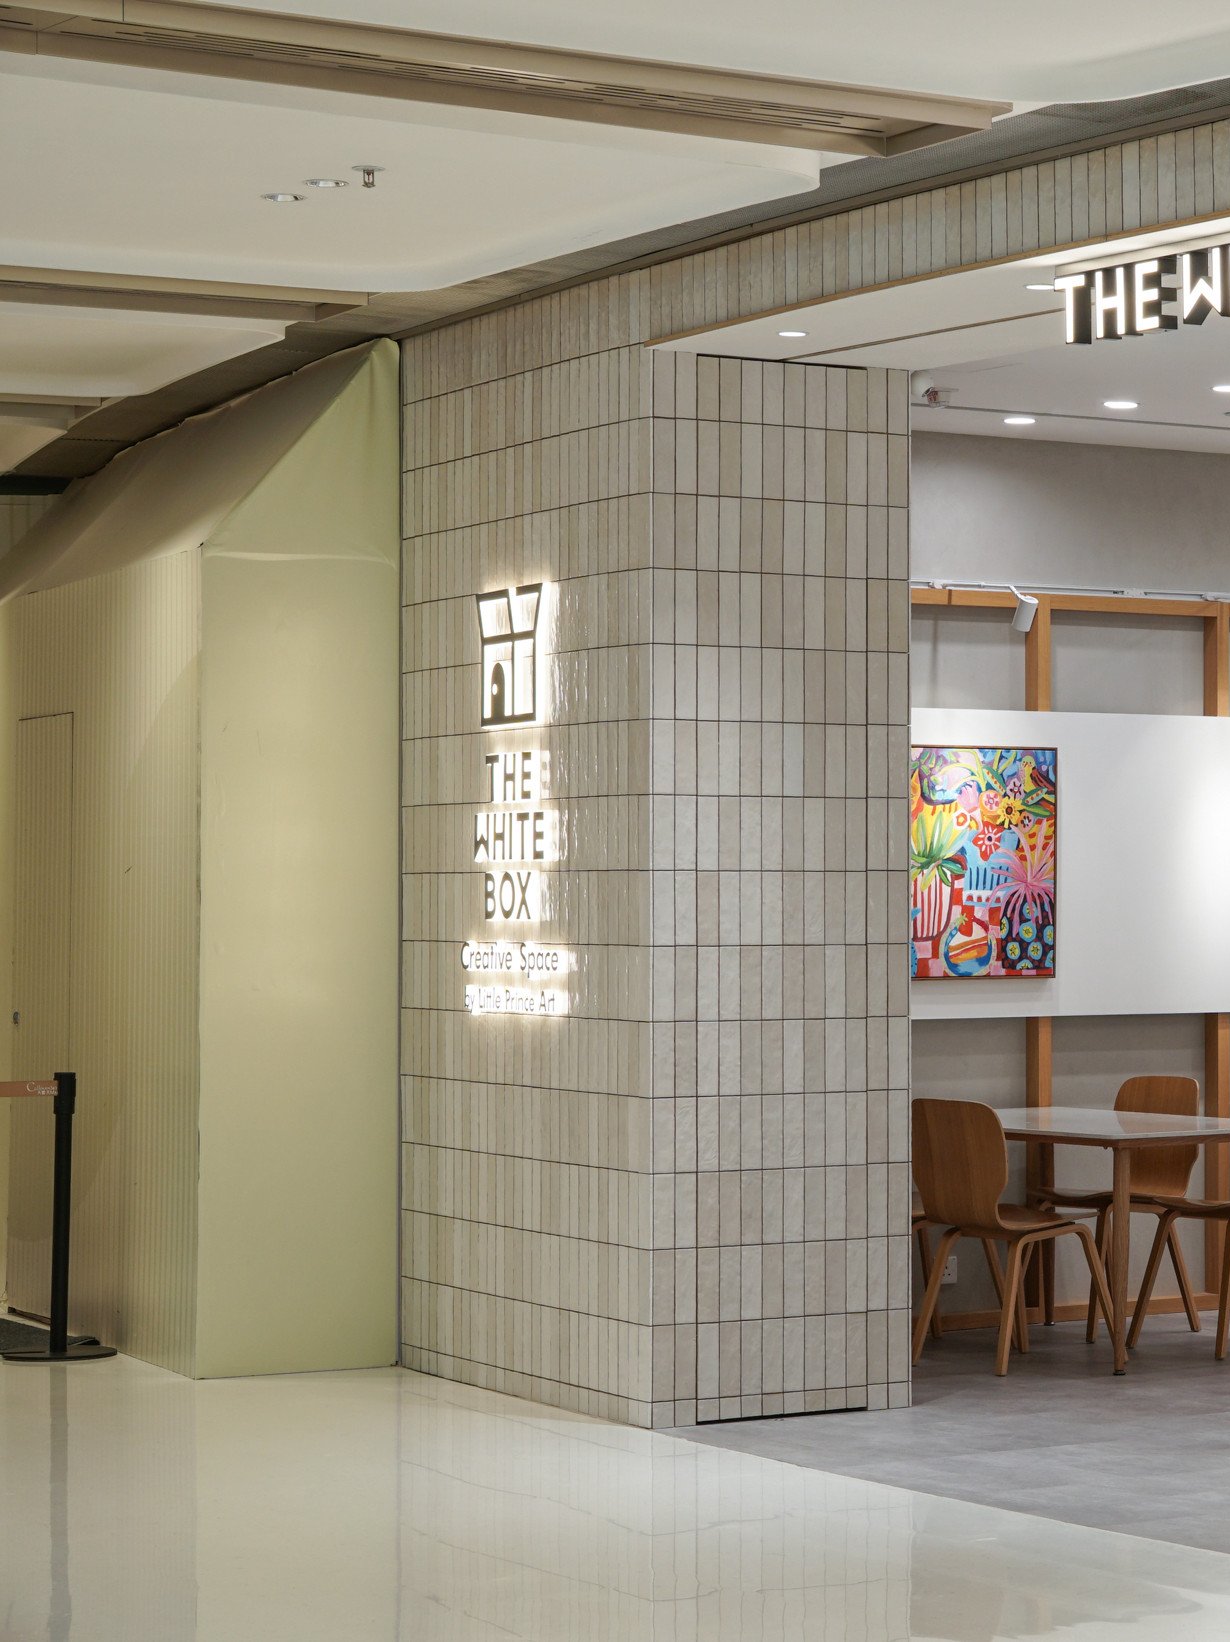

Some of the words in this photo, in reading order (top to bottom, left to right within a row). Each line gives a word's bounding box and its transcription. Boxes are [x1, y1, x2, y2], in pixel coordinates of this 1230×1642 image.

[1054, 259, 1160, 344] THE
[486, 751, 532, 801] THE
[474, 811, 545, 862] WHITE
[485, 871, 532, 921] BOX
[460, 941, 513, 970] Creative
[519, 942, 559, 978] Space
[464, 985, 476, 1013] by
[478, 987, 502, 1010] Little
[505, 989, 535, 1012] Prince
[538, 990, 555, 1012] Art
